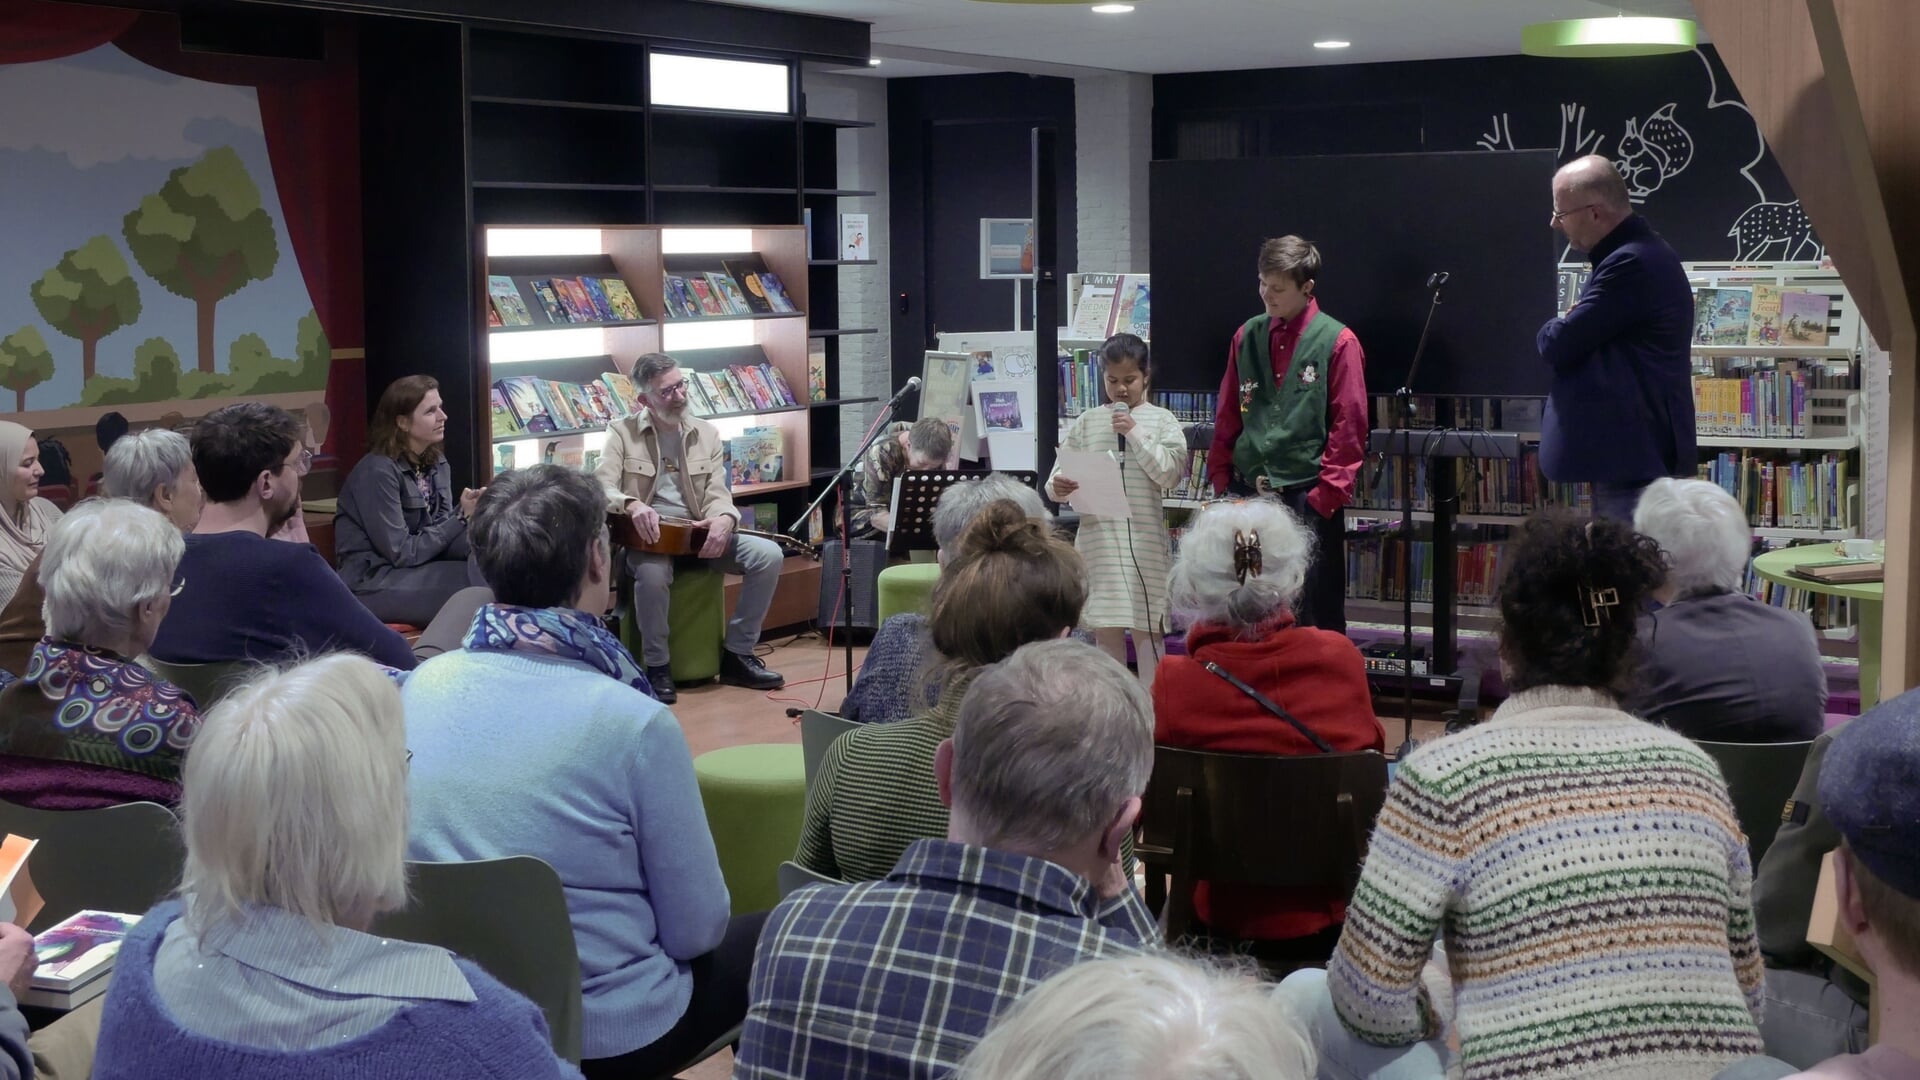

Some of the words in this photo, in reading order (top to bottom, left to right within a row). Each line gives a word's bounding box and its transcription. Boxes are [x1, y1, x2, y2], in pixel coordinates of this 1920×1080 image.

[1560, 275, 1566, 284] R
[1579, 275, 1587, 284] U
[1559, 288, 1566, 296] S
[1558, 300, 1564, 310] T
